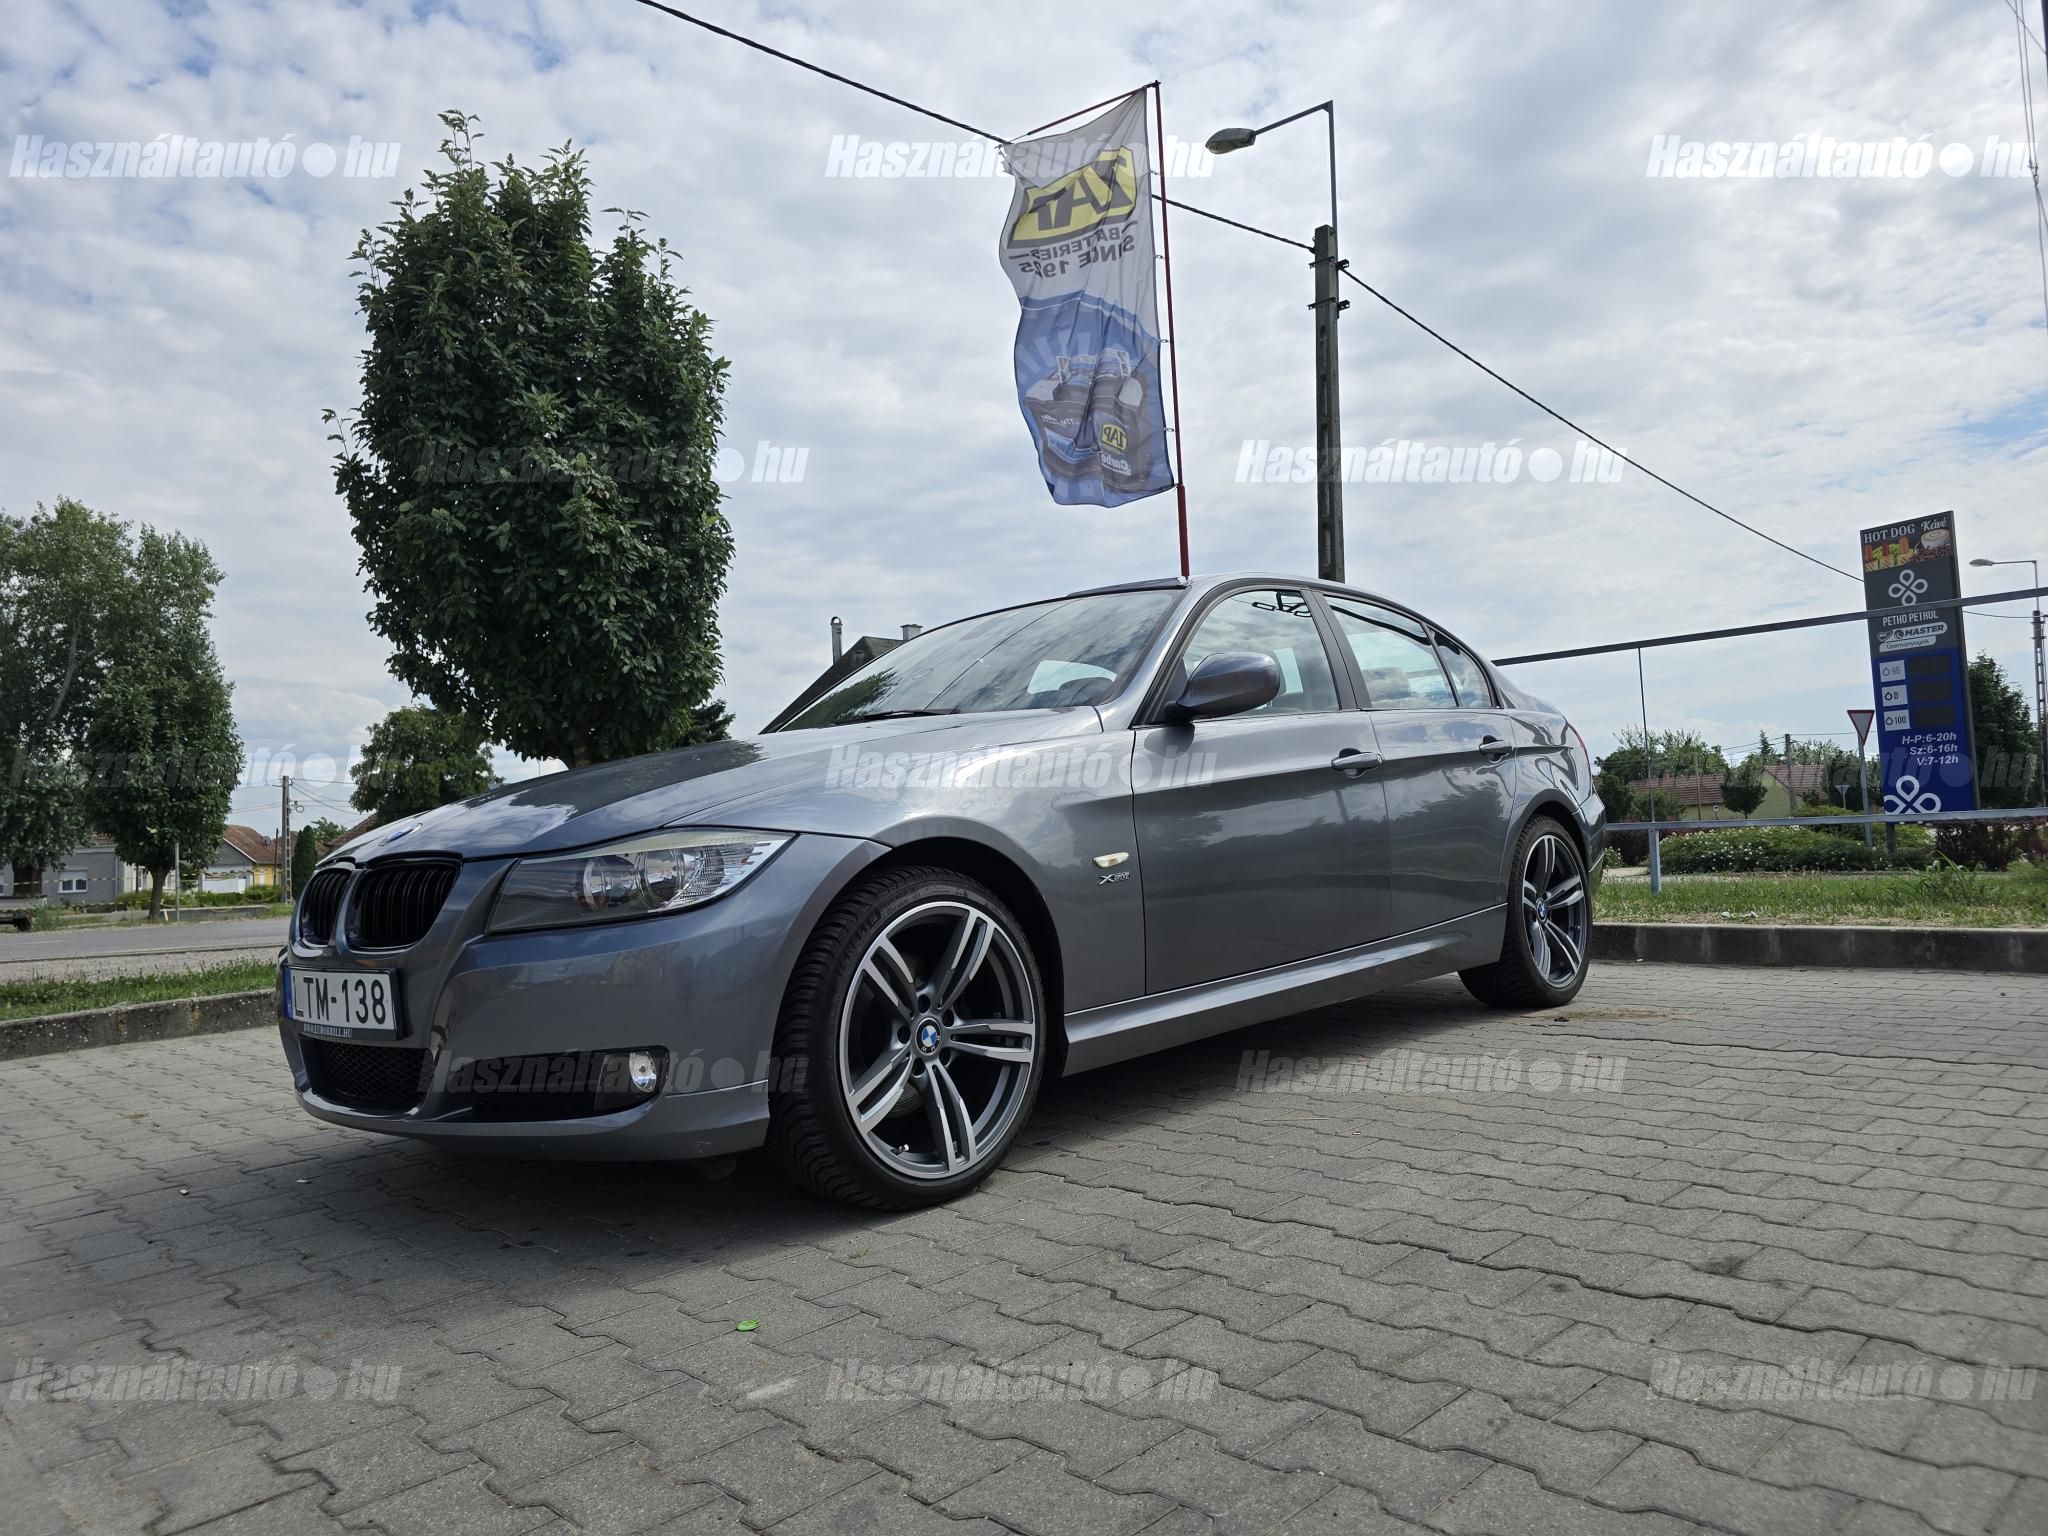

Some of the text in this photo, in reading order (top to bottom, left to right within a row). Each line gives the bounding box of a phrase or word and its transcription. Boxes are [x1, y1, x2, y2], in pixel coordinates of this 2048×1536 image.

[1864, 517, 1947, 543] HOT DOG Kávé
[1905, 624, 1945, 637] MASTER
[1891, 666, 1900, 675] 95
[1894, 716, 1907, 725] 100
[1902, 732, 1957, 745] H-P:6-20h
[1909, 743, 1958, 755] Sz:6-16h
[1917, 755, 1959, 766] V:7-12h
[293, 976, 386, 1025] LTM-138
